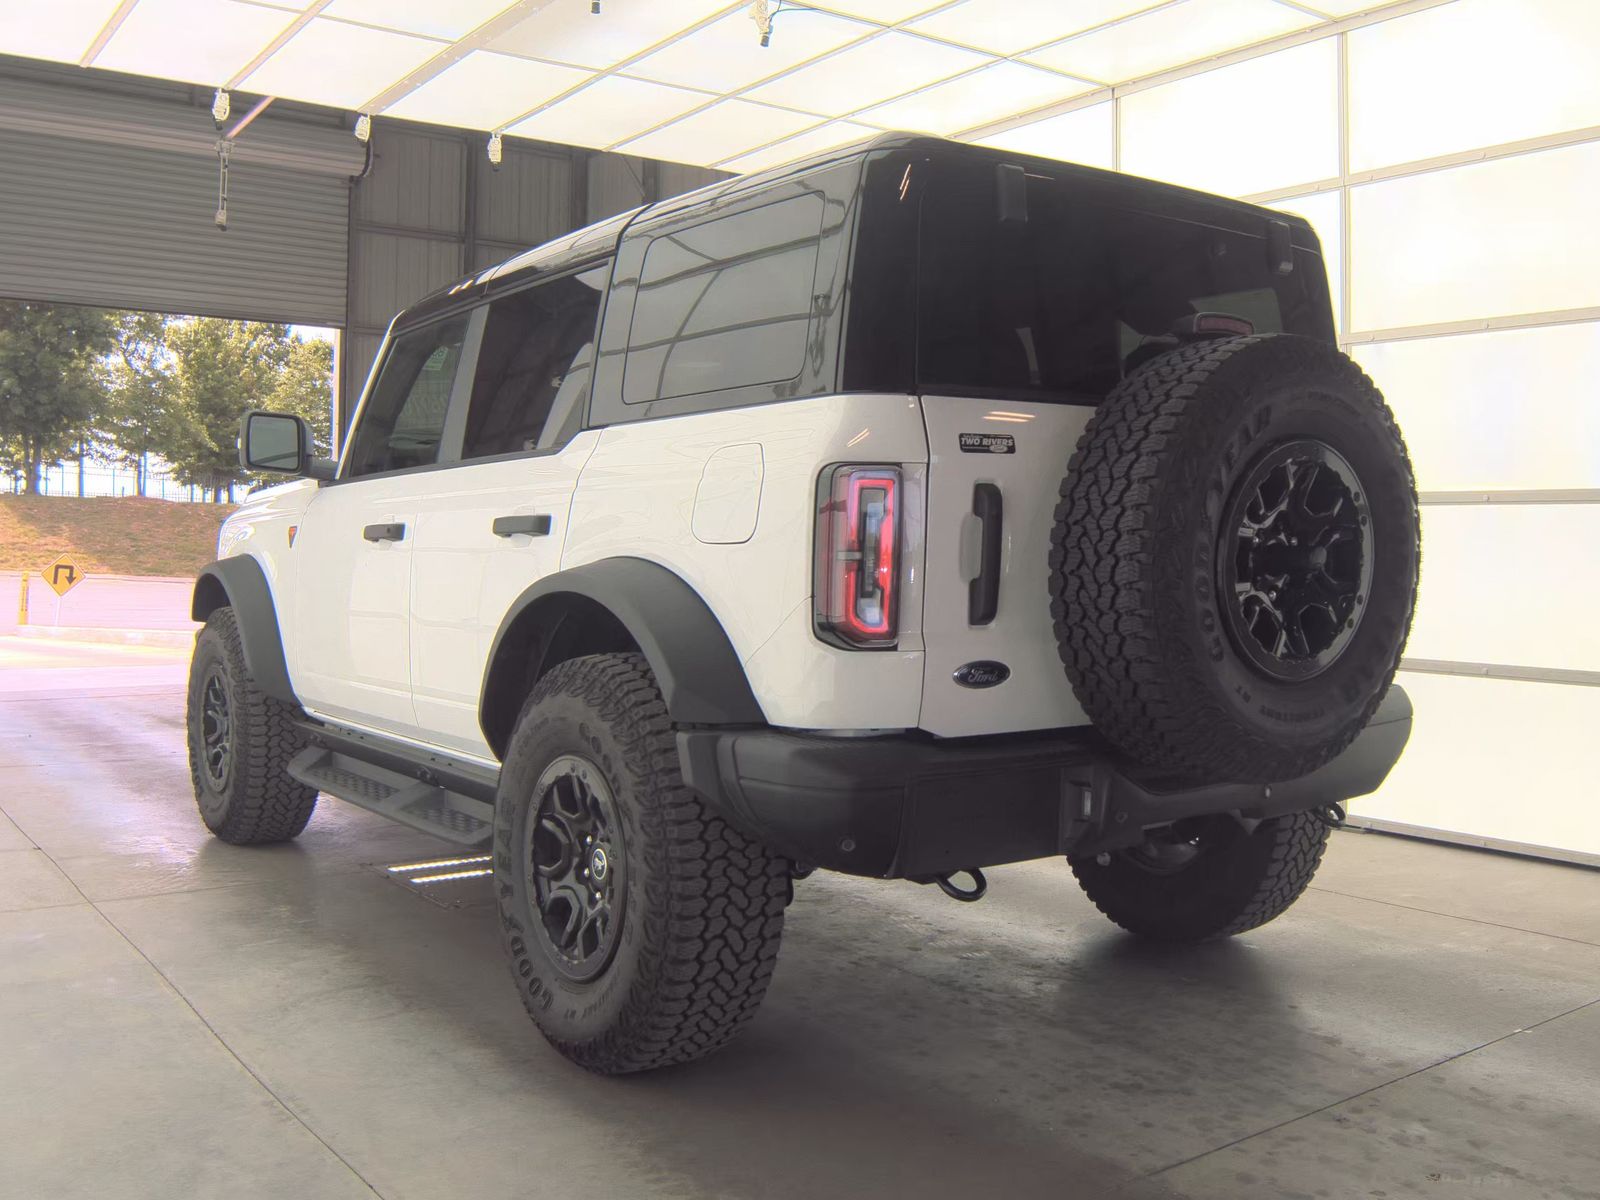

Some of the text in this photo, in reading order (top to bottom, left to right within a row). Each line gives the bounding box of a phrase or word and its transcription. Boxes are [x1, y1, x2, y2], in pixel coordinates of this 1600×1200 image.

[960, 437, 1014, 447] TWO RIVERS
[498, 797, 554, 1010] GOODYEAR
